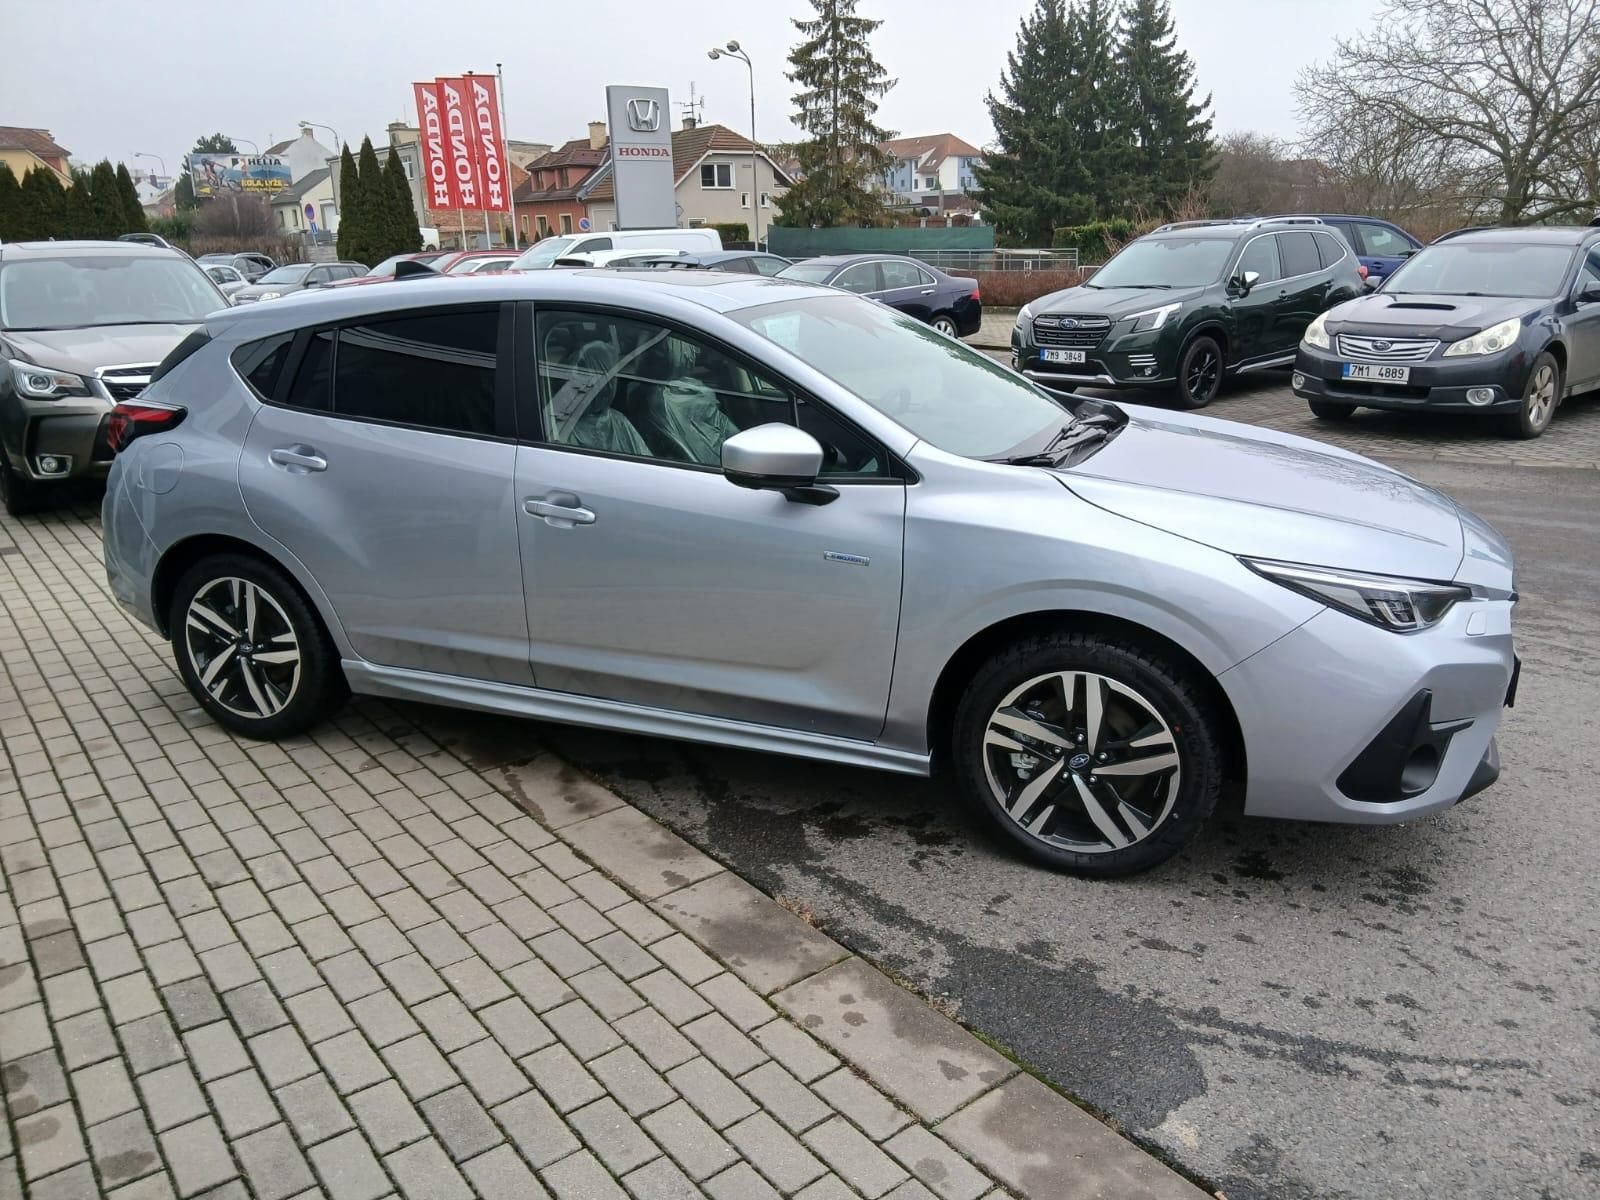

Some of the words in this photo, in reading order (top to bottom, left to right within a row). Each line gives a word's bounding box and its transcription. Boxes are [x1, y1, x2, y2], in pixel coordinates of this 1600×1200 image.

[618, 147, 670, 157] HONDA
[1046, 350, 1060, 360] 7M9
[1351, 364, 1370, 377] 7M1
[1378, 367, 1405, 379] 4889
